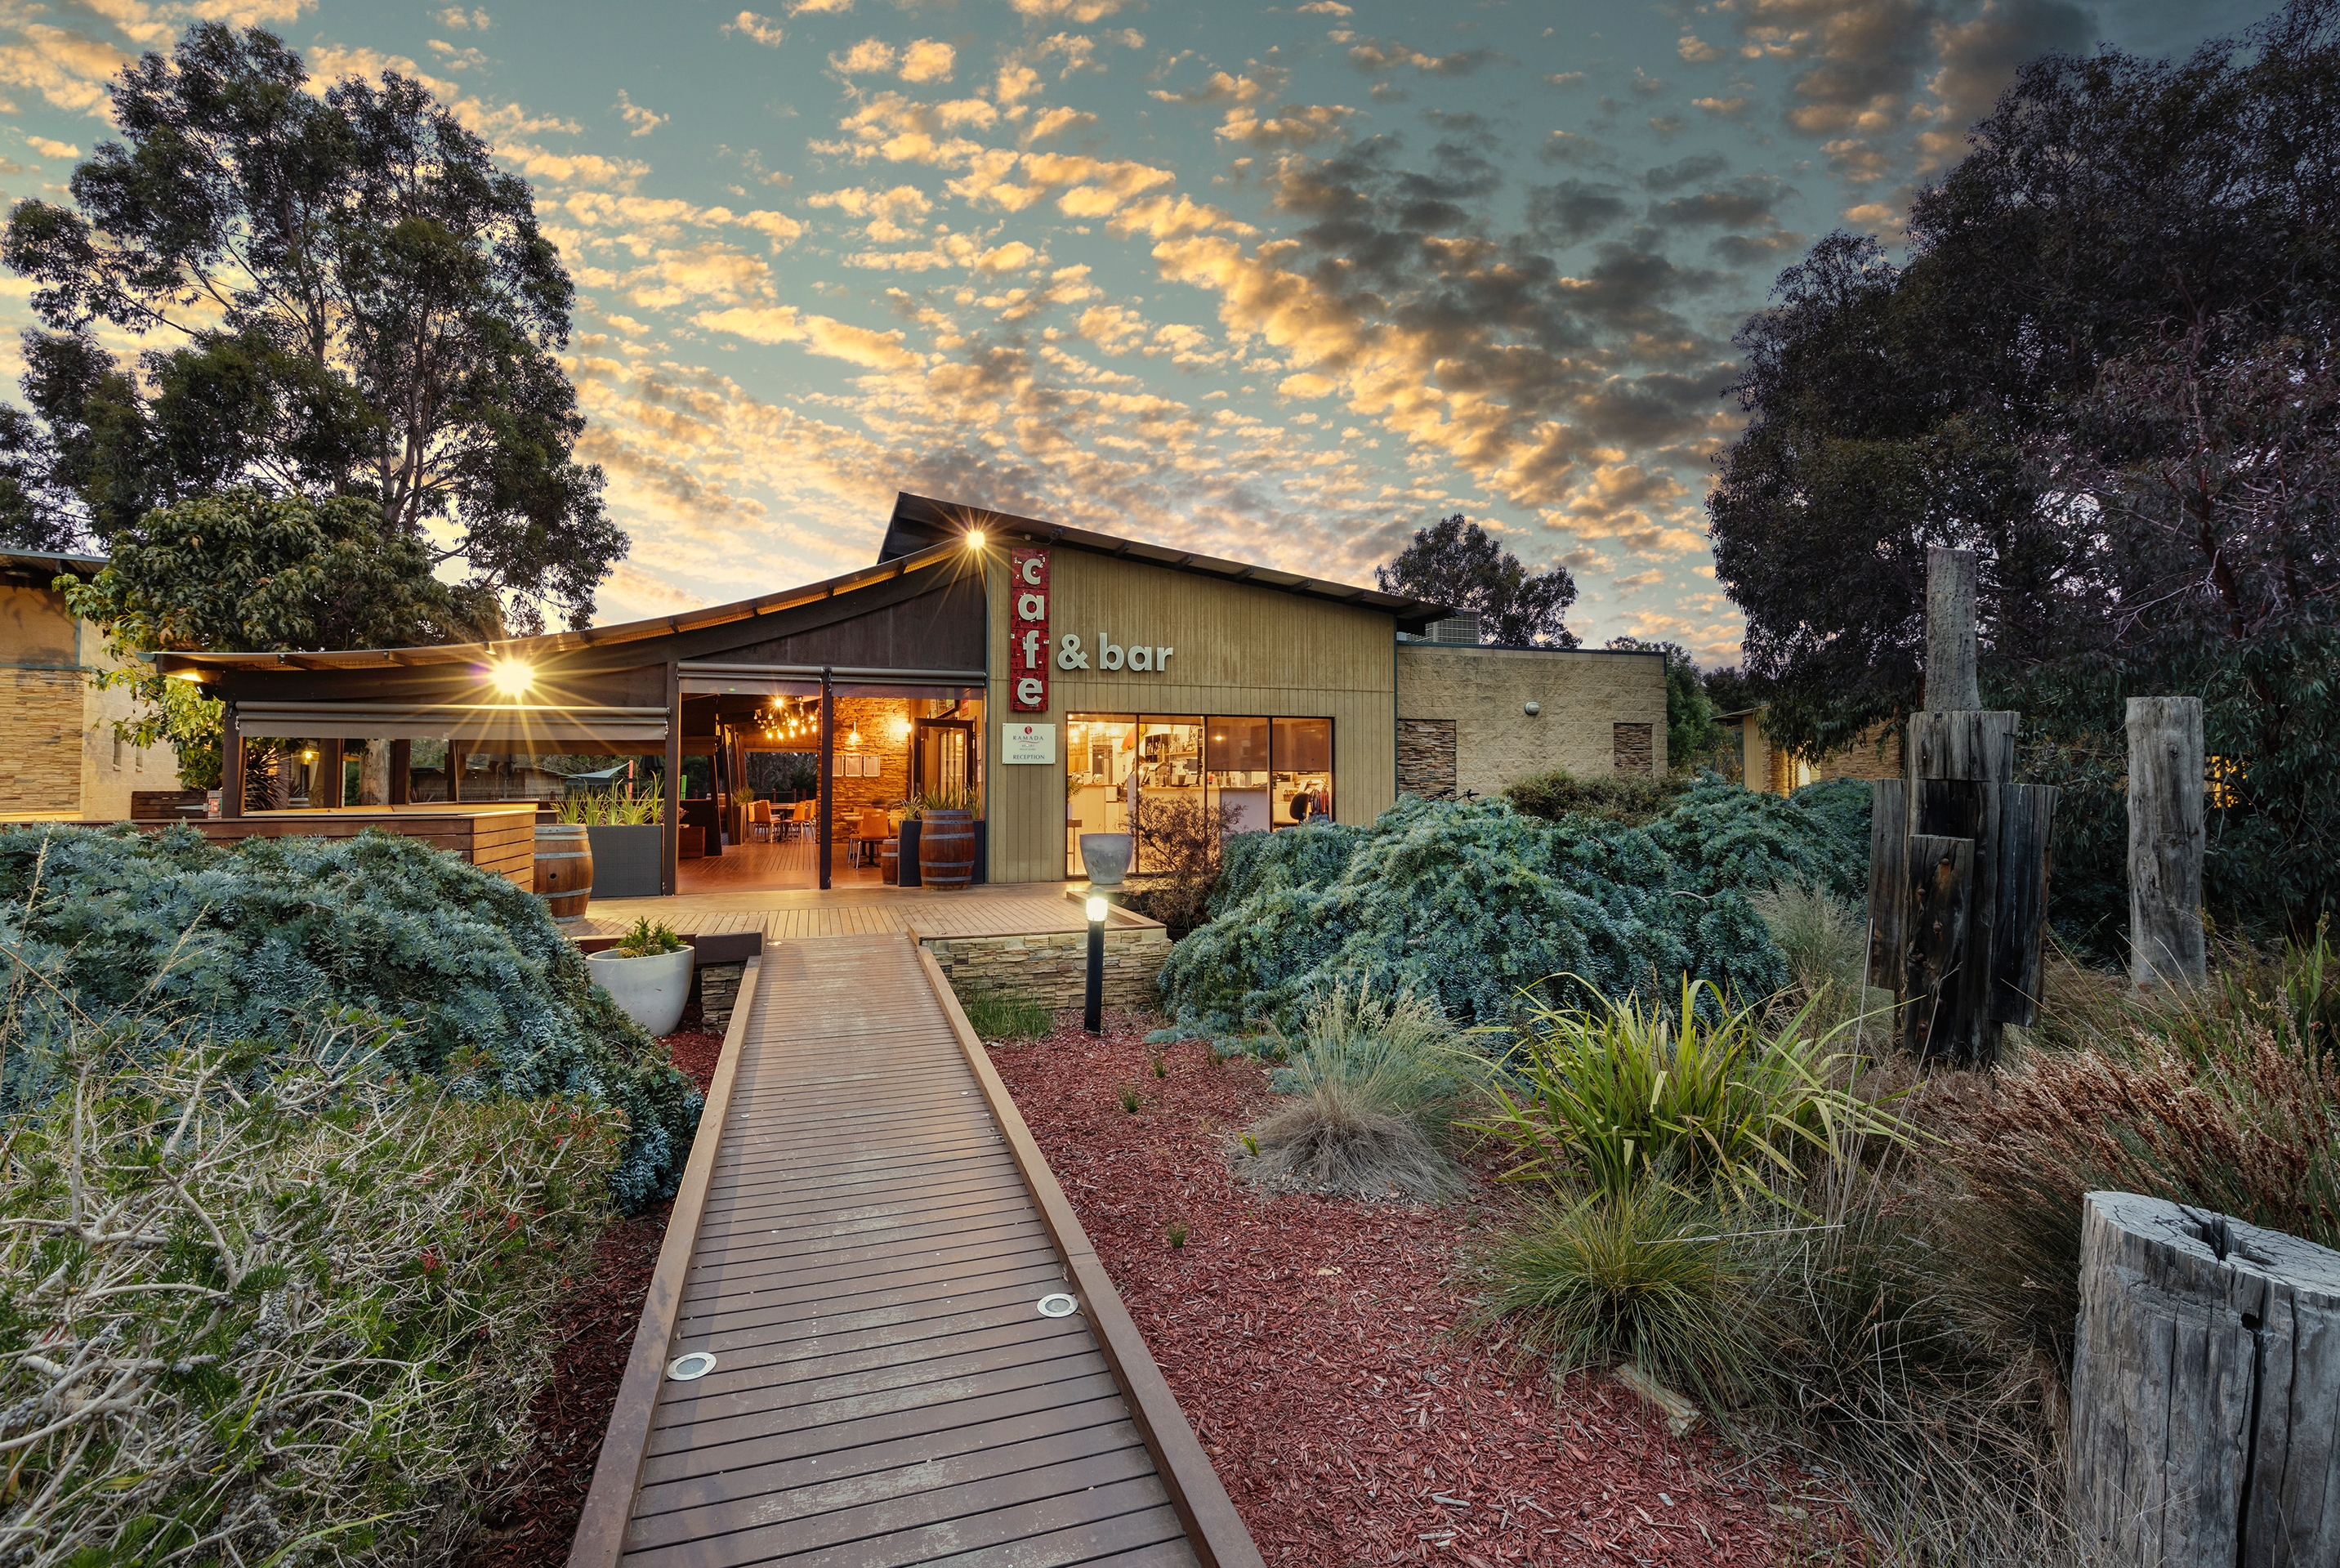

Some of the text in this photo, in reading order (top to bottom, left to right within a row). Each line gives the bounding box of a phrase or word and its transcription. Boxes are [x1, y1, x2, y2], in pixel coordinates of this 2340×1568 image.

[1017, 558, 1044, 704] cafe
[1057, 634, 1090, 670] &
[1099, 632, 1173, 671] bar
